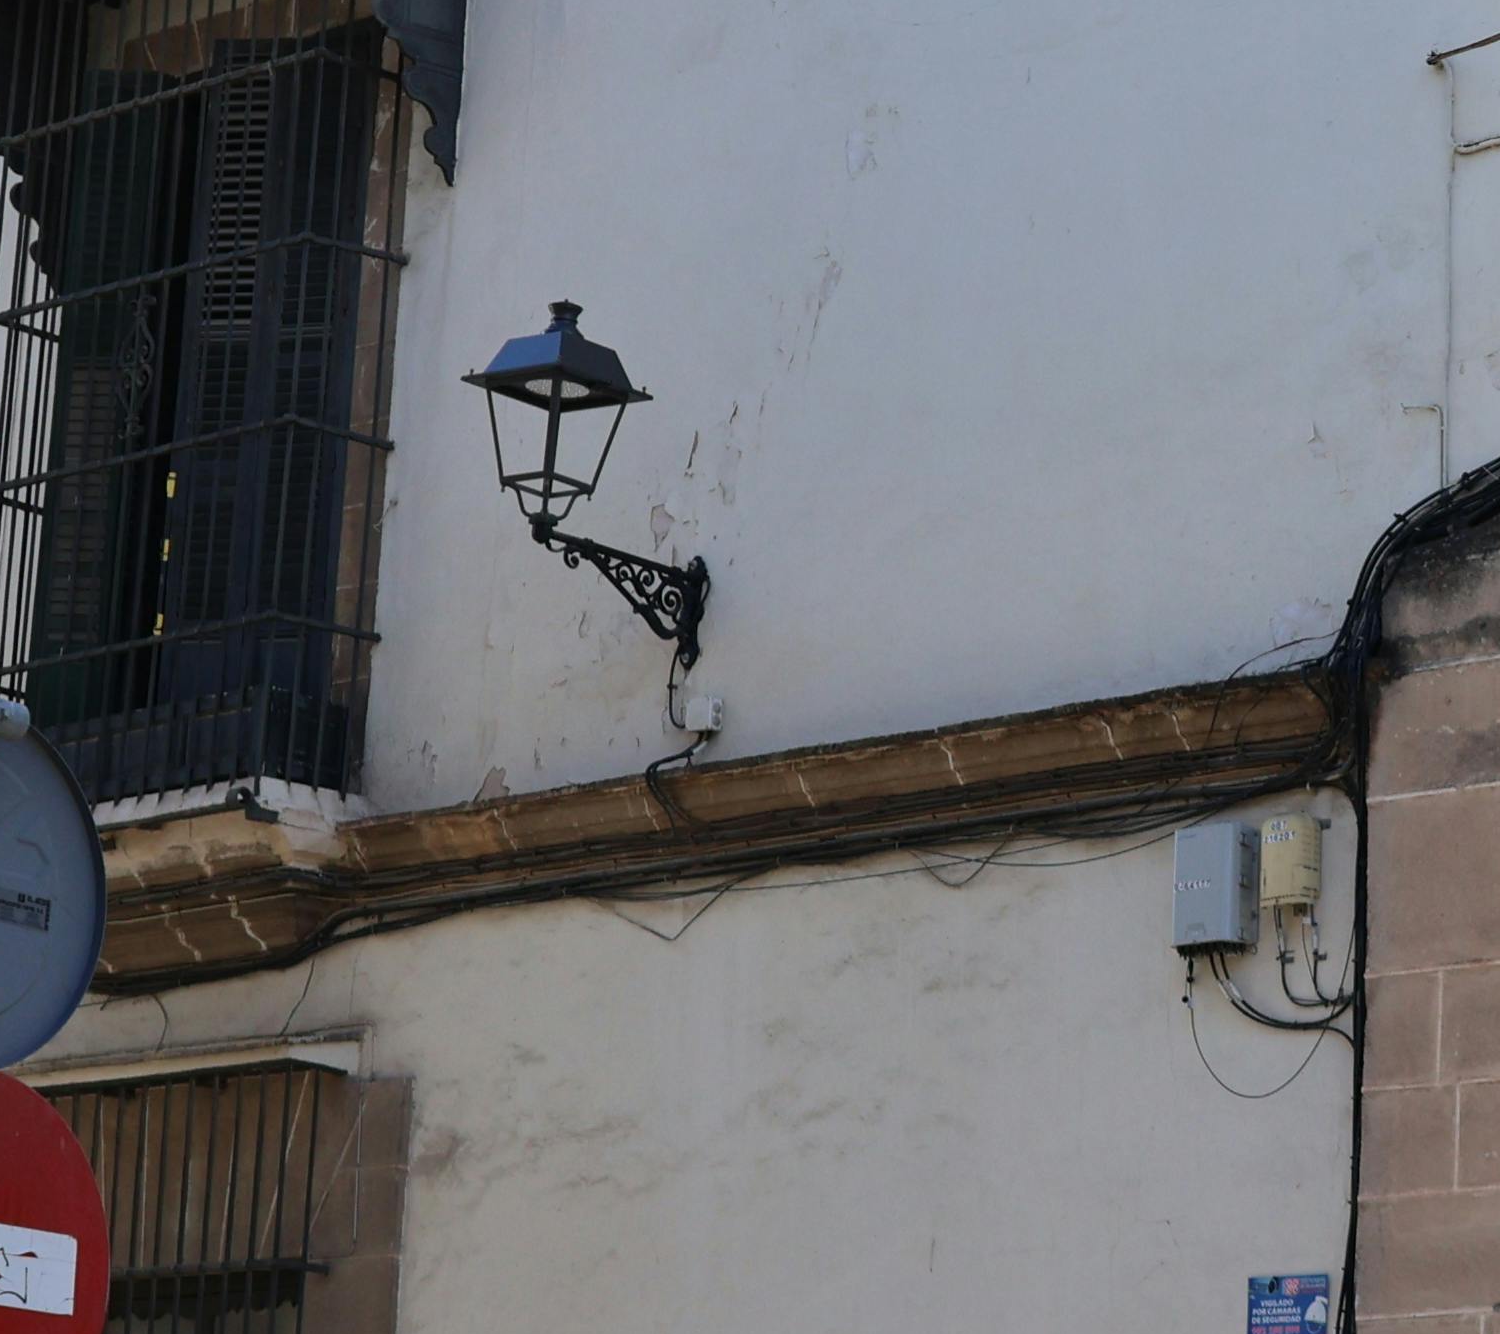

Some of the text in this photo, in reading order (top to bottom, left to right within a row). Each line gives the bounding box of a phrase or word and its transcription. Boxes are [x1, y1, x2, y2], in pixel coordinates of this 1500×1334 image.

[1260, 1298, 1294, 1307] VIGILADO
[1252, 1307, 1267, 1316] POR
[1251, 1315, 1301, 1325] DE SEGURIDAD
